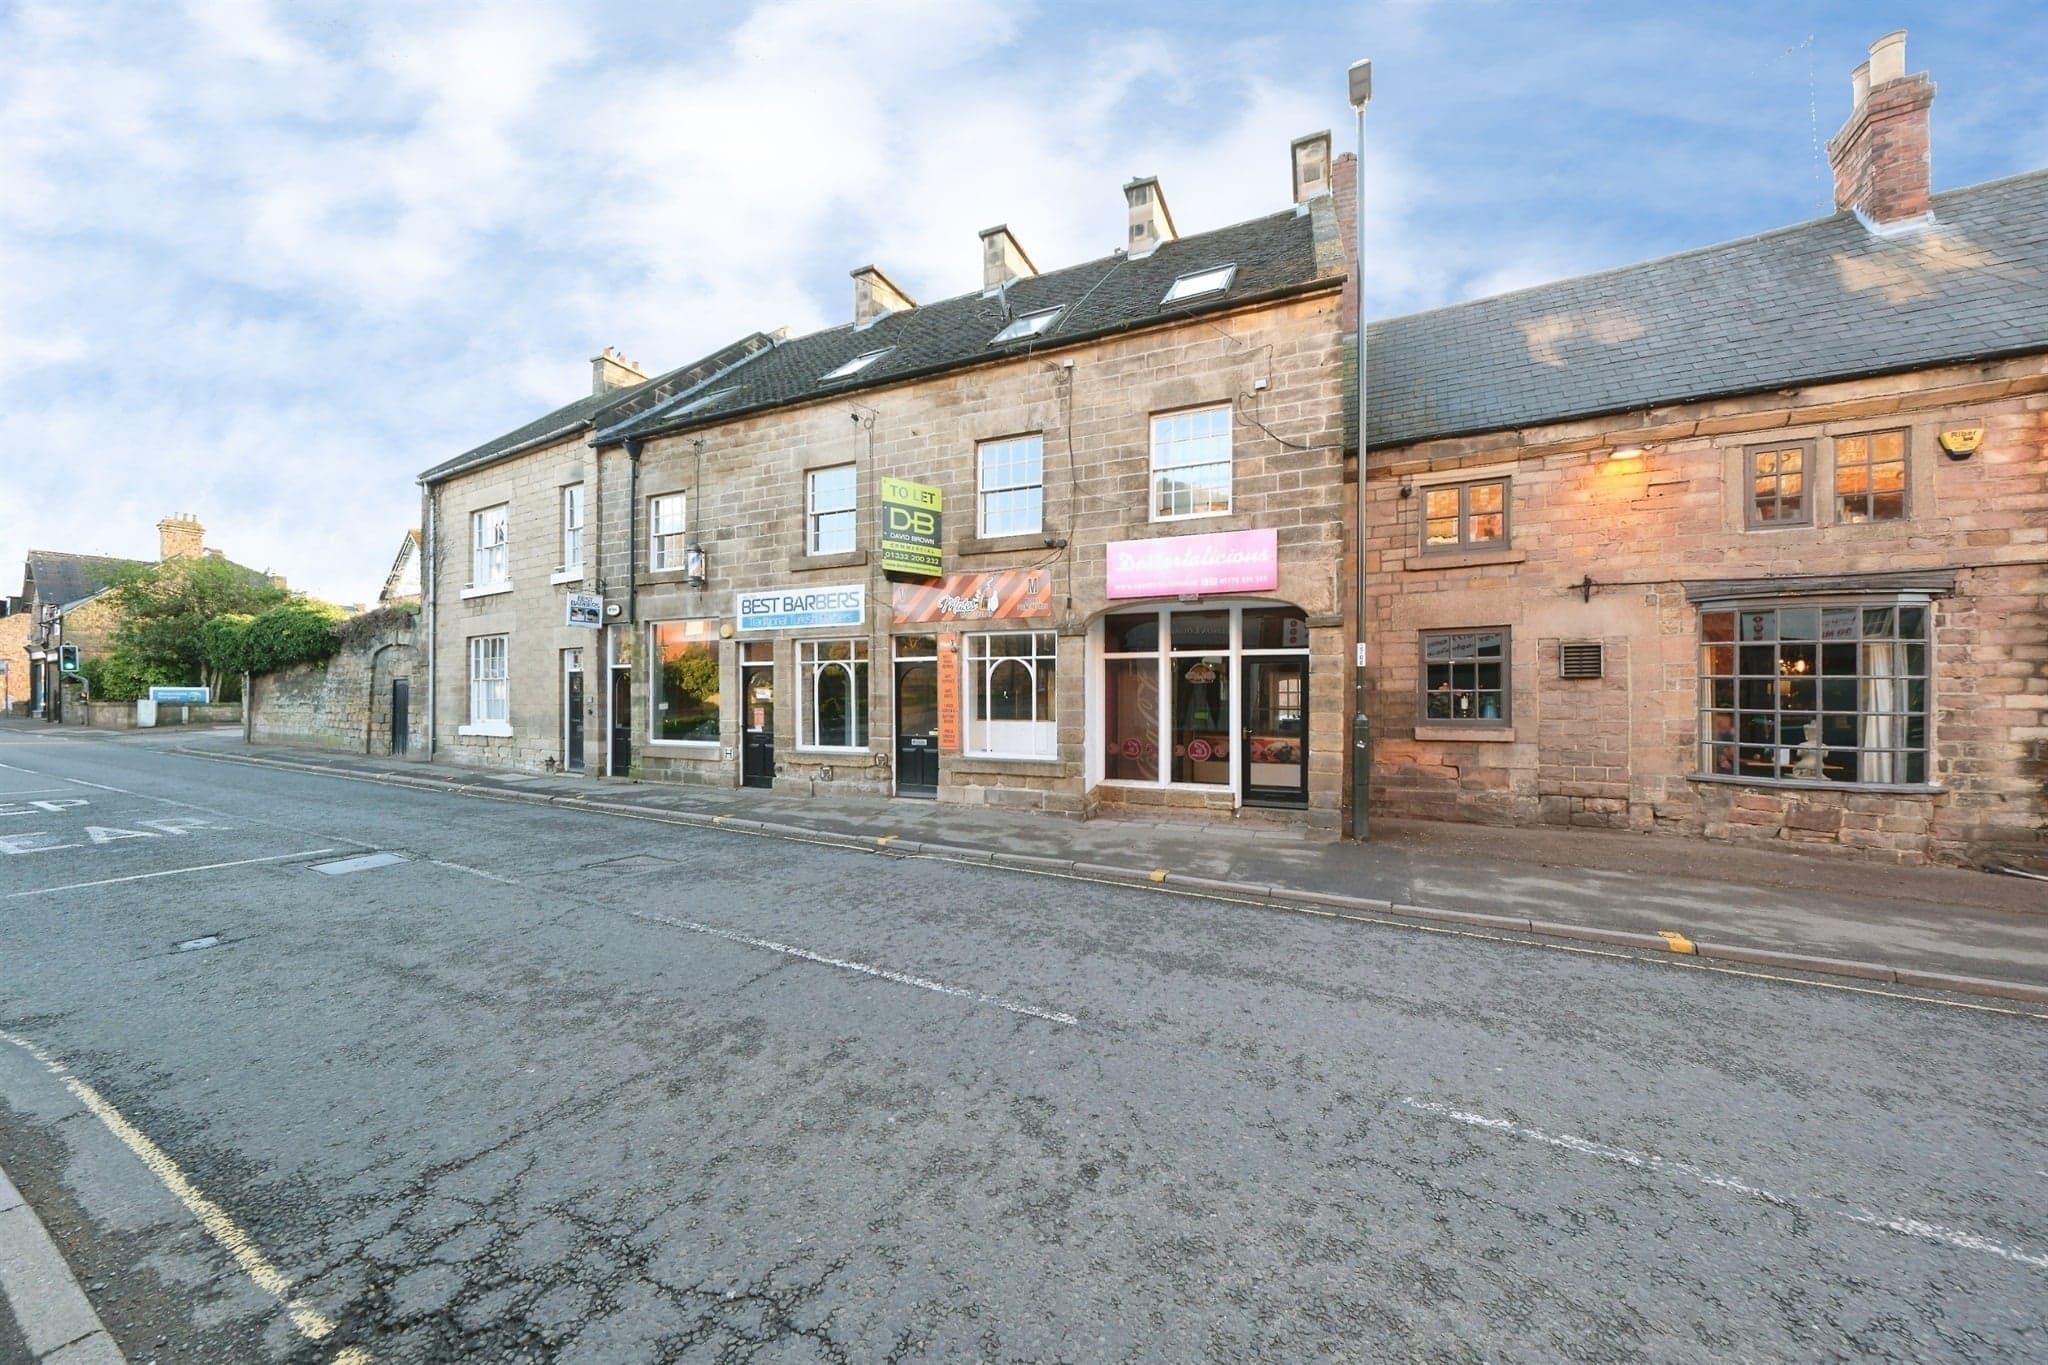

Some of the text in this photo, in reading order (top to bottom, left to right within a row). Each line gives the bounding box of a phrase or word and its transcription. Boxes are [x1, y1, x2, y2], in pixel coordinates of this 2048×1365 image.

[1951, 430, 1977, 438] Riber
[890, 485, 936, 505] TO LET
[890, 506, 935, 536] DB
[889, 532, 935, 545] DAVID BROWN
[885, 551, 910, 561] 01332
[911, 553, 925, 562] 200
[741, 592, 860, 615] BEST BARBERS
